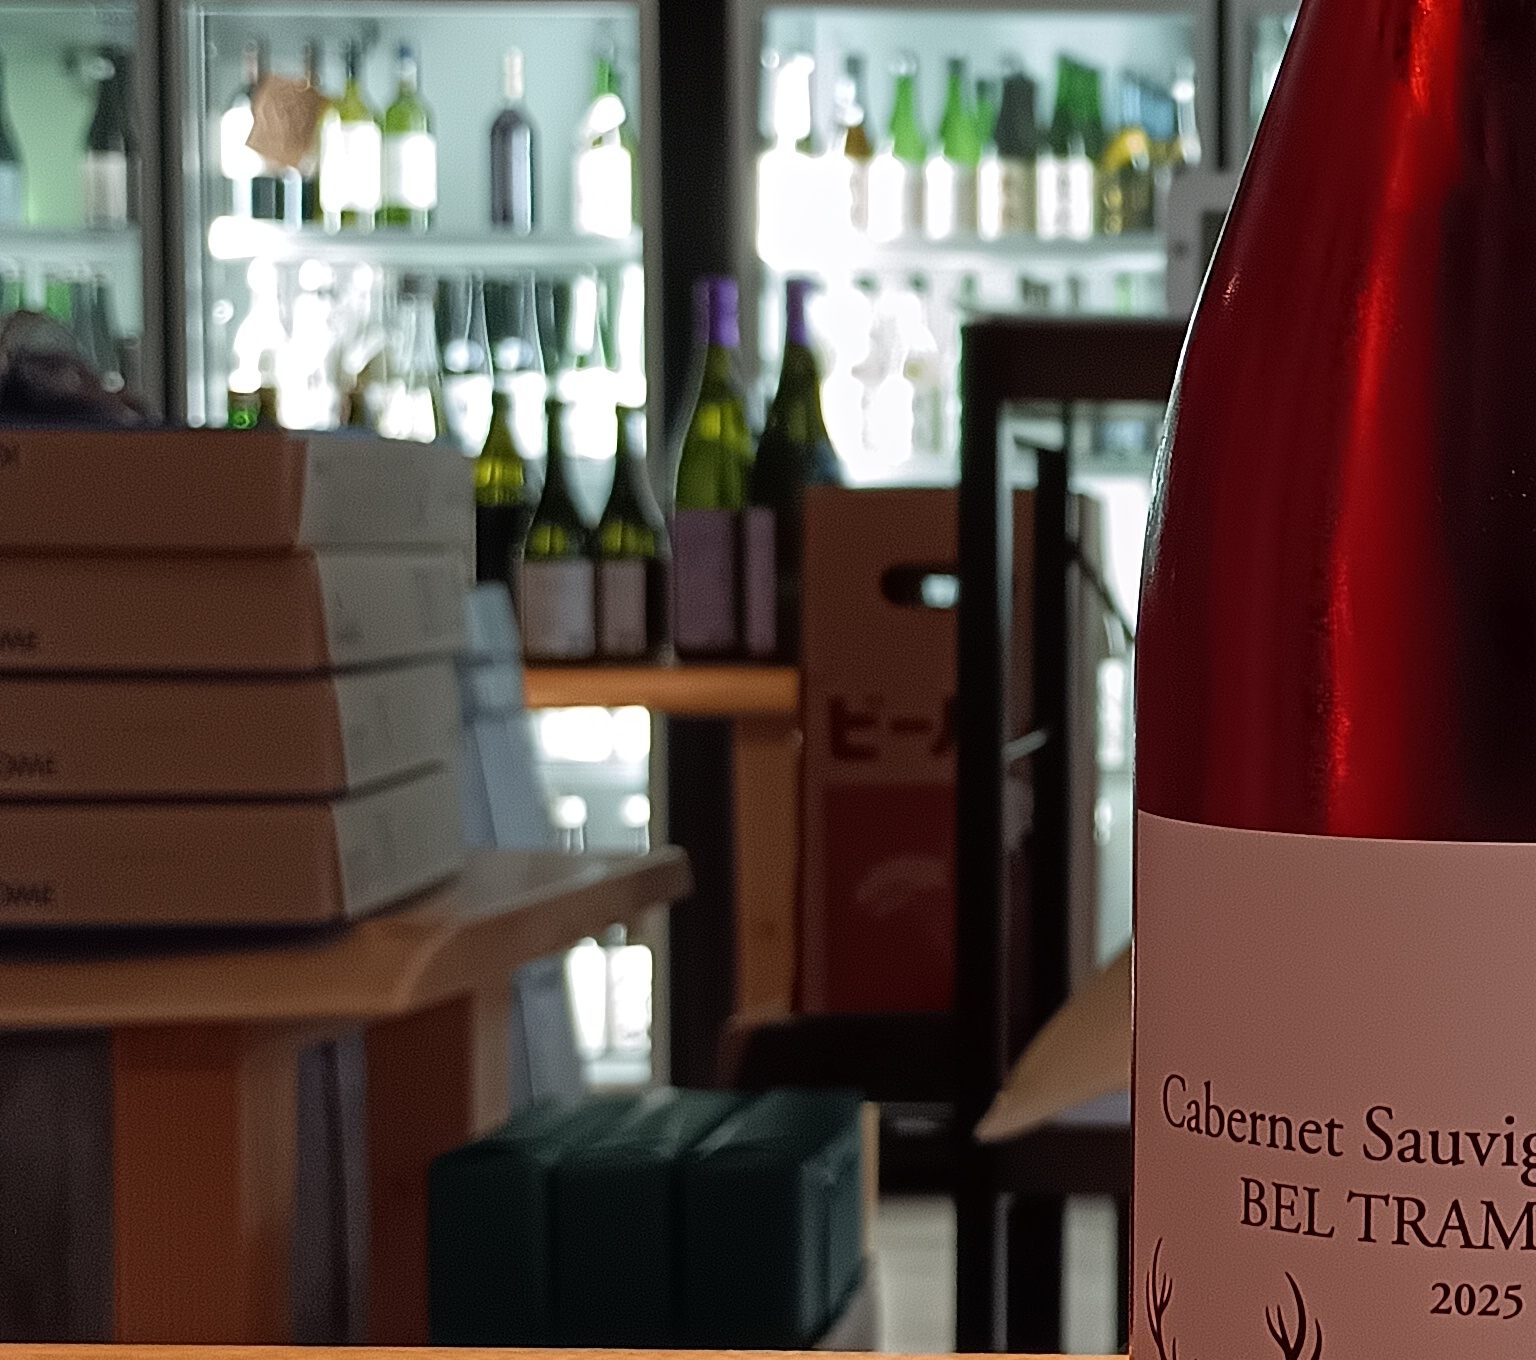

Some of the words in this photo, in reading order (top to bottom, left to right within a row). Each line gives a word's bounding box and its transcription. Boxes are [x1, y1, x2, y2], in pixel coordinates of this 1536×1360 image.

[1162, 1073, 1344, 1158] Cabernet
[1240, 1176, 1335, 1239] BEL
[1429, 1282, 1523, 1320] 2025
